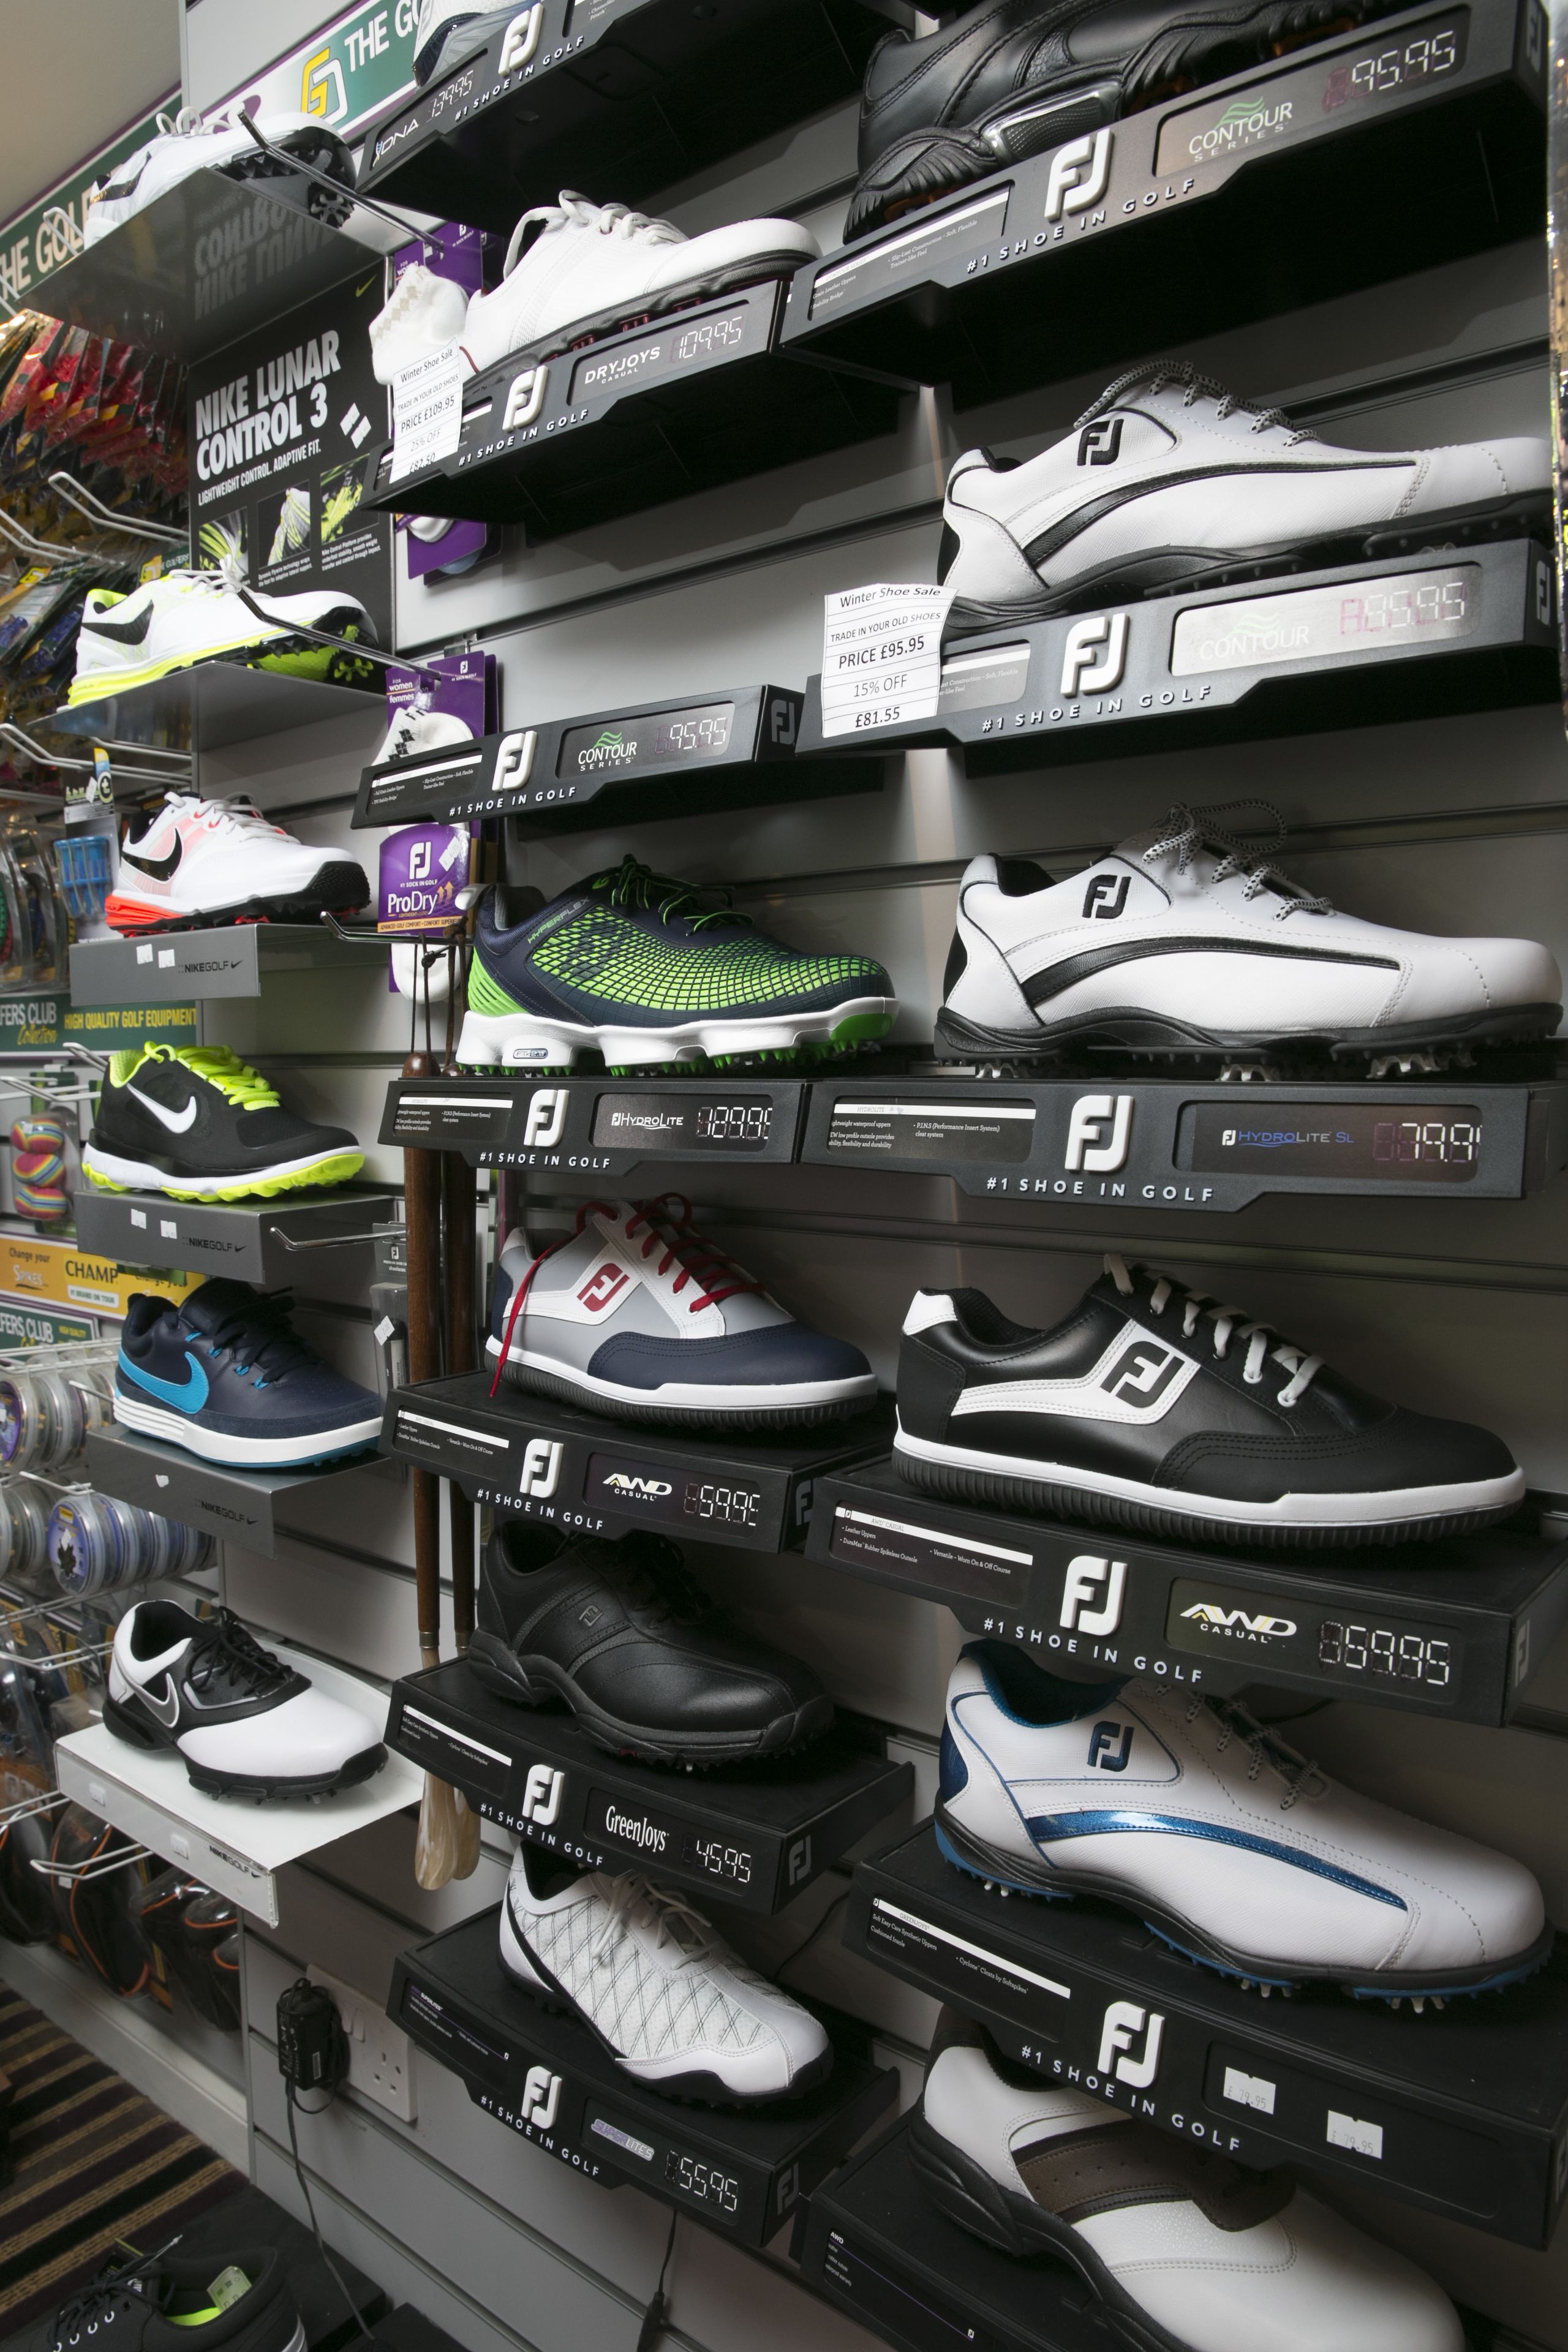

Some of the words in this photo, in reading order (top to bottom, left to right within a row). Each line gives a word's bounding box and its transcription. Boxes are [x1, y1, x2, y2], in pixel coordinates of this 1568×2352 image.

[344, 10, 390, 72] THE
[498, 2, 544, 77] FJ
[455, 107, 468, 122] #1
[473, 79, 510, 109] SHOE
[519, 64, 534, 80] IN
[543, 36, 585, 66] GOLF
[1189, 102, 1292, 155] CONTOUR
[1194, 124, 1284, 162] SERIES
[1045, 127, 1112, 222] FJ
[967, 255, 988, 273] #1
[1000, 226, 1063, 260] SHOE
[1081, 210, 1105, 230] IN
[1123, 179, 1194, 214] GOLF
[401, 363, 423, 383] Winter
[423, 355, 440, 371] Shoe
[440, 347, 453, 364] Sale
[584, 346, 660, 385] DRYJOYS
[601, 368, 638, 384] CASUAL
[196, 375, 249, 440] NIKE
[257, 330, 341, 410] LUNAR
[398, 399, 412, 412] TRADE
[419, 390, 432, 402] YOUR
[433, 385, 442, 396] OLD
[443, 375, 459, 391] SHOES
[502, 365, 549, 431] FJ
[197, 395, 302, 481] CONTROL
[311, 382, 328, 428] 3
[401, 412, 423, 434] PRICE
[424, 395, 455, 421] £109.95
[411, 438, 426, 452] 25%
[426, 428, 441, 445] OFF
[459, 453, 472, 466] #1
[477, 436, 514, 458] SHOE
[522, 427, 537, 442] IN
[546, 409, 588, 431] GOLF
[198, 478, 240, 507] LIGHTWEIGHT
[241, 462, 273, 488] CONTROL.
[274, 447, 307, 473] ADAPTIVE
[307, 439, 322, 458] FIT.
[840, 589, 876, 608] Winter
[879, 587, 910, 598] Shoe
[913, 587, 941, 597] Sale
[831, 628, 856, 643] TRADE
[858, 626, 867, 635] IN
[868, 620, 890, 633] YOUR
[892, 616, 908, 627] OLD
[910, 612, 941, 622] SHOES
[1200, 625, 1310, 660] CONTOUR
[839, 648, 876, 669] PRICE
[880, 636, 925, 660] £95.95
[1060, 612, 1129, 697] FJ
[389, 682, 413, 692] women
[389, 693, 415, 704] femmes
[854, 680, 880, 697] 15%
[883, 674, 908, 691] OFF
[855, 706, 900, 728] £81.55
[982, 717, 1004, 733] #1
[1015, 705, 1079, 726] SHOE
[1096, 699, 1122, 714] IN
[1139, 686, 1211, 709] GOLF
[492, 731, 537, 792] FJ
[578, 741, 637, 766] CONTOUR
[581, 757, 631, 771] SERIES
[449, 806, 462, 816] #1
[467, 799, 504, 814] SHOE
[511, 794, 527, 805] IN
[535, 786, 576, 802] GOLF
[388, 891, 438, 915] ProDry
[527, 897, 590, 944] HYPERFLEX
[184, 961, 228, 973] NIKEGOLF
[28, 1002, 56, 1024] CLUB
[64, 1014, 84, 1030] HIGH
[85, 1012, 120, 1029] QUALITY
[122, 1011, 145, 1028] GOLF
[145, 1008, 196, 1027] EQUIPMENT
[524, 1089, 570, 1147] FJ
[1064, 1095, 1134, 1172] FJ
[1335, 1131, 1354, 1144] SL
[480, 1152, 492, 1162] #1
[499, 1153, 535, 1165] SHOE
[545, 1155, 560, 1166] IN
[569, 1156, 611, 1169] GOLF
[986, 1178, 1008, 1191] #1
[1020, 1179, 1084, 1196] SHOE
[1100, 1183, 1126, 1198] IN
[1142, 1185, 1213, 1203] GOLF
[9, 1248, 33, 1263] Change
[34, 1254, 50, 1264] your
[189, 1237, 233, 1252] NIKEGOLF
[65, 1260, 119, 1284] CHAMP
[26, 1318, 54, 1343] CLUB
[519, 1438, 564, 1498] FJ
[603, 1473, 673, 1494] AWD
[201, 1500, 245, 1523] NIKEGOLF
[477, 1489, 489, 1501] #1
[495, 1494, 532, 1513] SHOE
[540, 1506, 555, 1518] IN
[563, 1512, 604, 1530] GOLF
[614, 1488, 654, 1502] CASUAL
[845, 1526, 861, 1536] Leather
[861, 1530, 876, 1539] Uppers
[843, 1537, 862, 1548] DuraMax
[864, 1544, 880, 1554] Rubber
[880, 1547, 900, 1559] Spikeless
[900, 1553, 918, 1563] Outsole
[933, 1549, 954, 1560] Versatile
[957, 1555, 971, 1564] Worn
[984, 1561, 993, 1570] Off
[993, 1564, 1011, 1575] Course
[1059, 1555, 1128, 1636] FJ
[1180, 1602, 1297, 1636] AWD
[1200, 1623, 1268, 1644] CASUAL
[984, 1617, 1005, 1634] #1
[1016, 1626, 1077, 1654] SHOE
[1093, 1646, 1117, 1664] IN
[1133, 1656, 1203, 1684] GOLF
[522, 1764, 564, 1826] FJ
[480, 1803, 493, 1815] #1
[497, 1811, 534, 1838] SHOE
[541, 1831, 556, 1846] IN
[565, 1841, 603, 1867] GOLF
[606, 1805, 666, 1853] GreenJoys
[209, 1844, 250, 1873] NIKEGOLF
[1097, 2000, 1166, 2089] FJ
[521, 2065, 562, 2129] FJ
[1022, 2045, 1042, 2064] #1
[1054, 2060, 1115, 2098] SHOE
[1131, 2094, 1156, 2116] IN
[1172, 2114, 1240, 2152] GOLF
[1239, 2089, 1267, 2109] 79.95
[481, 2095, 493, 2109] #1
[499, 2106, 532, 2136] SHOE
[540, 2133, 554, 2150] IN
[562, 2147, 600, 2176] GOLF
[592, 2119, 655, 2161] SUPERLITES
[1344, 2133, 1374, 2155] 79.95
[830, 2231, 844, 2245] AWD
